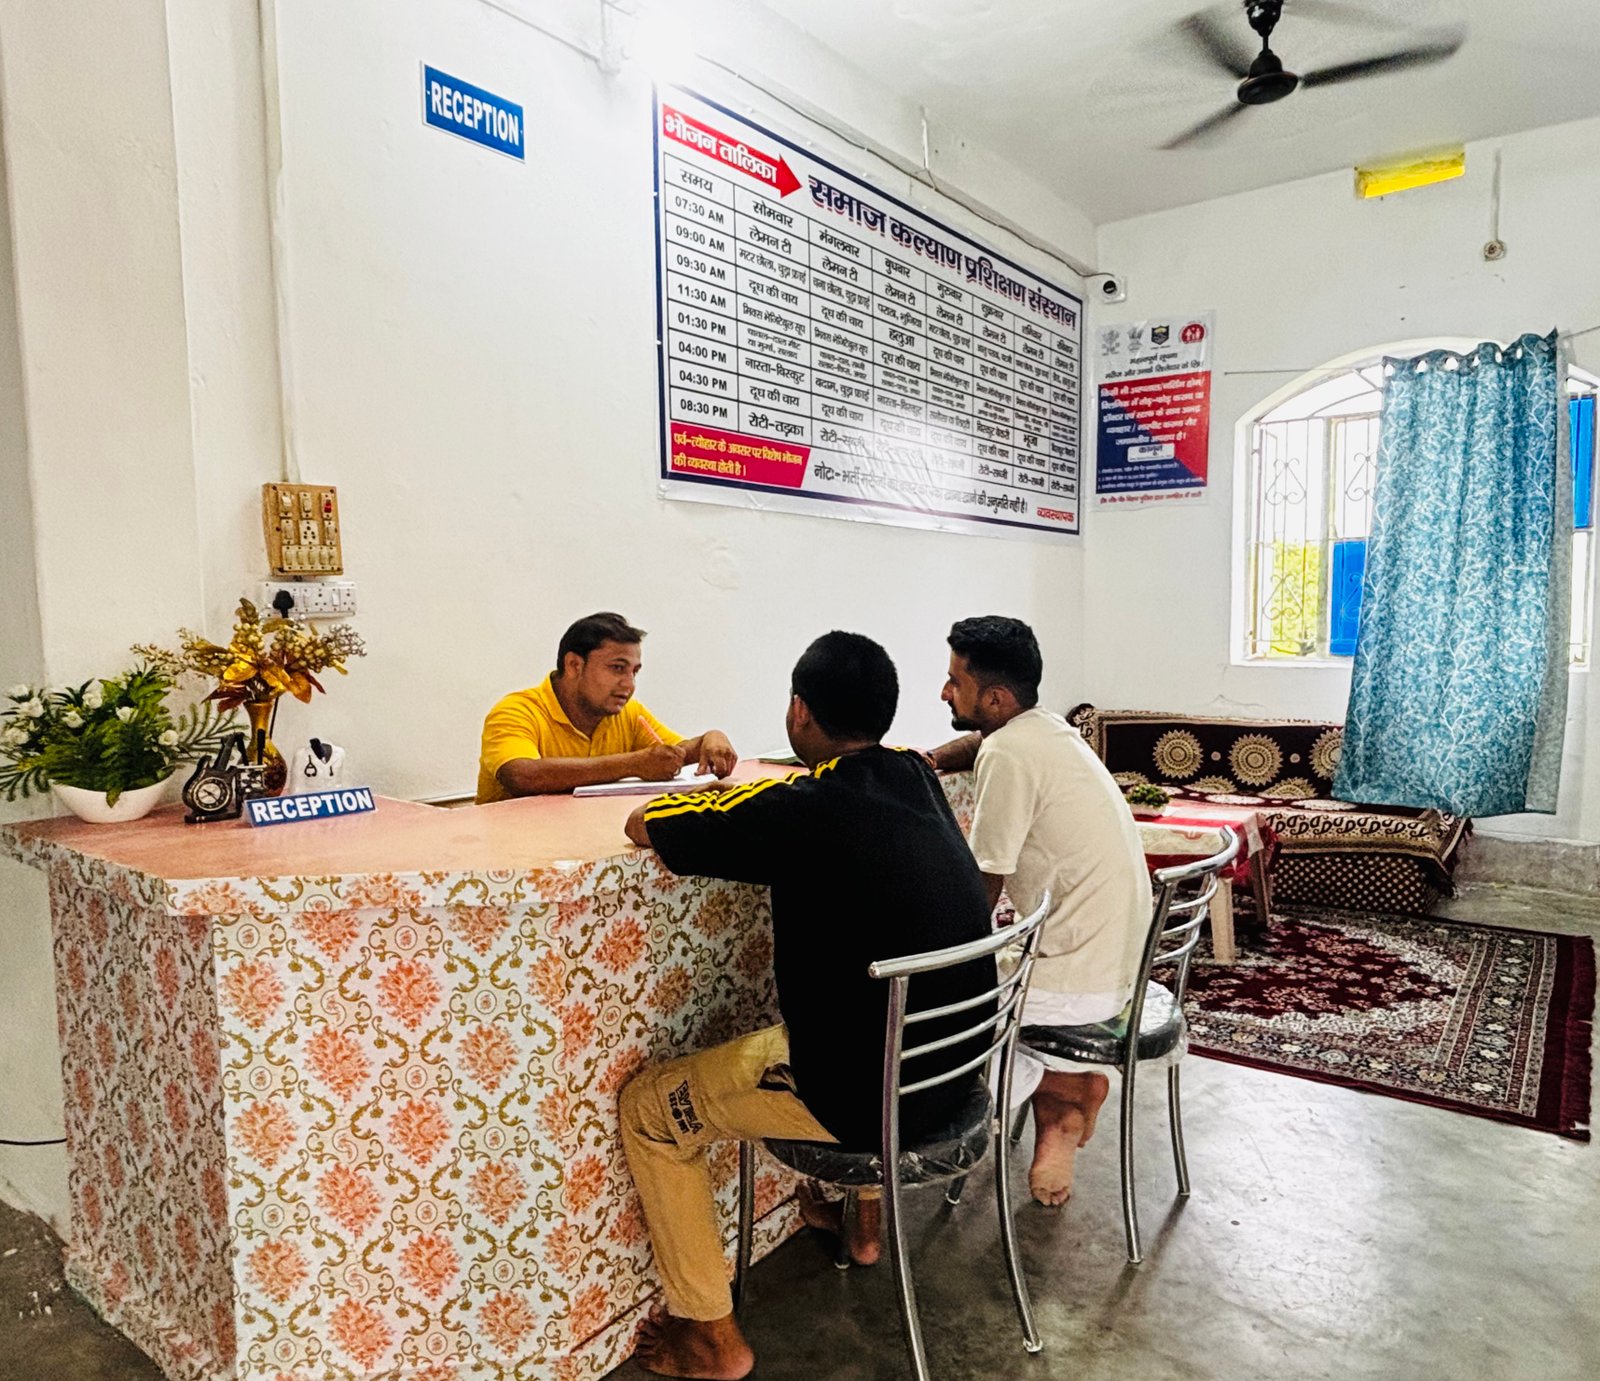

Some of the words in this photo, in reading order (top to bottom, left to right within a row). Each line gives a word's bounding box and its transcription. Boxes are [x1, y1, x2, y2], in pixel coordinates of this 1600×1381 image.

[431, 80, 519, 146] RECEPTION
[665, 113, 716, 155] भोजन
[720, 143, 777, 183] तालिका
[681, 170, 713, 193] समय
[675, 195, 705, 216] 07:30
[708, 209, 723, 224] AM
[752, 200, 793, 228] सोमवार
[675, 225, 705, 245] 09:00
[708, 237, 724, 252] AM
[749, 225, 779, 249] लेमन
[781, 238, 792, 254] टी
[819, 229, 860, 258] मंगलवार
[808, 174, 887, 237] समाज
[889, 216, 962, 274] कल्याण
[963, 255, 1026, 306] प्रशिक्षण
[1027, 286, 1076, 330] संस्थान
[676, 254, 706, 273] 09:30
[709, 266, 725, 280] AM
[822, 255, 847, 277] लेमन
[849, 266, 858, 282] टी
[677, 283, 707, 302] 11:30
[710, 294, 726, 308] AM
[748, 279, 764, 295] दूध
[765, 284, 779, 298] की
[780, 291, 798, 305] चाय
[884, 282, 906, 302] लेमन
[907, 291, 915, 306] टी
[677, 311, 707, 330] 01:30
[710, 321, 726, 335] PM
[821, 305, 834, 320] दूध
[835, 310, 847, 323] की
[678, 341, 708, 358] 04:00
[711, 349, 726, 363] PM
[894, 353, 905, 367] की
[679, 369, 708, 386] 04:30
[711, 377, 727, 391] PM
[680, 398, 709, 414] 08:30
[712, 405, 727, 418] PM
[749, 385, 765, 401] दूध
[766, 388, 780, 402] की
[782, 393, 800, 407] चाय
[673, 452, 686, 467] की
[252, 789, 373, 823] RECEPTION
